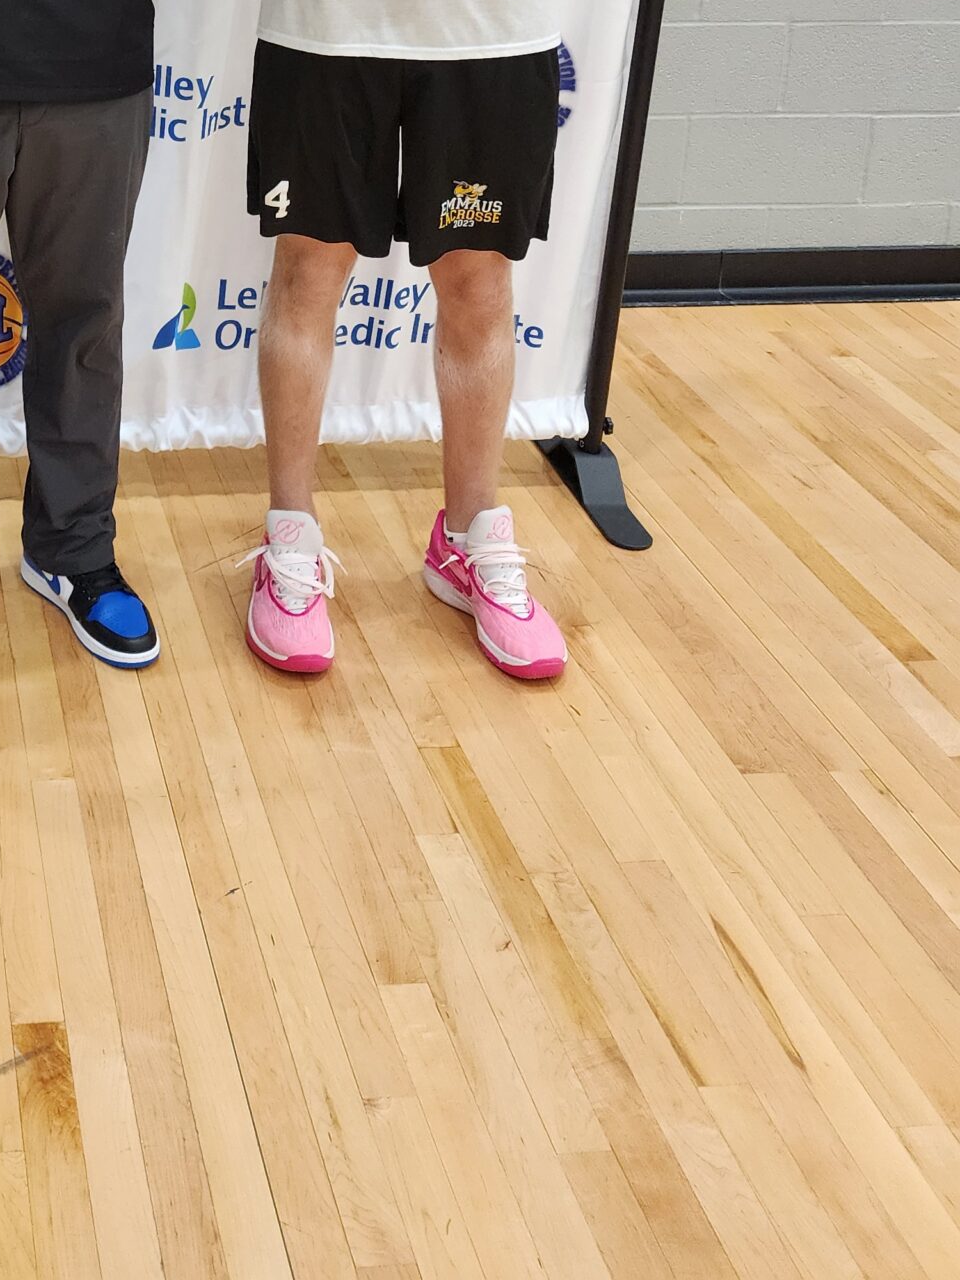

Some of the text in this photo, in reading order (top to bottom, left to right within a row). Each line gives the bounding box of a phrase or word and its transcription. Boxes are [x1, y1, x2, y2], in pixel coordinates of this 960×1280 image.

[154, 64, 214, 109] lley
[265, 180, 290, 218] 4
[440, 197, 503, 217] EMMAUS
[438, 209, 501, 229] LACROSSE
[453, 219, 475, 229] 2023
